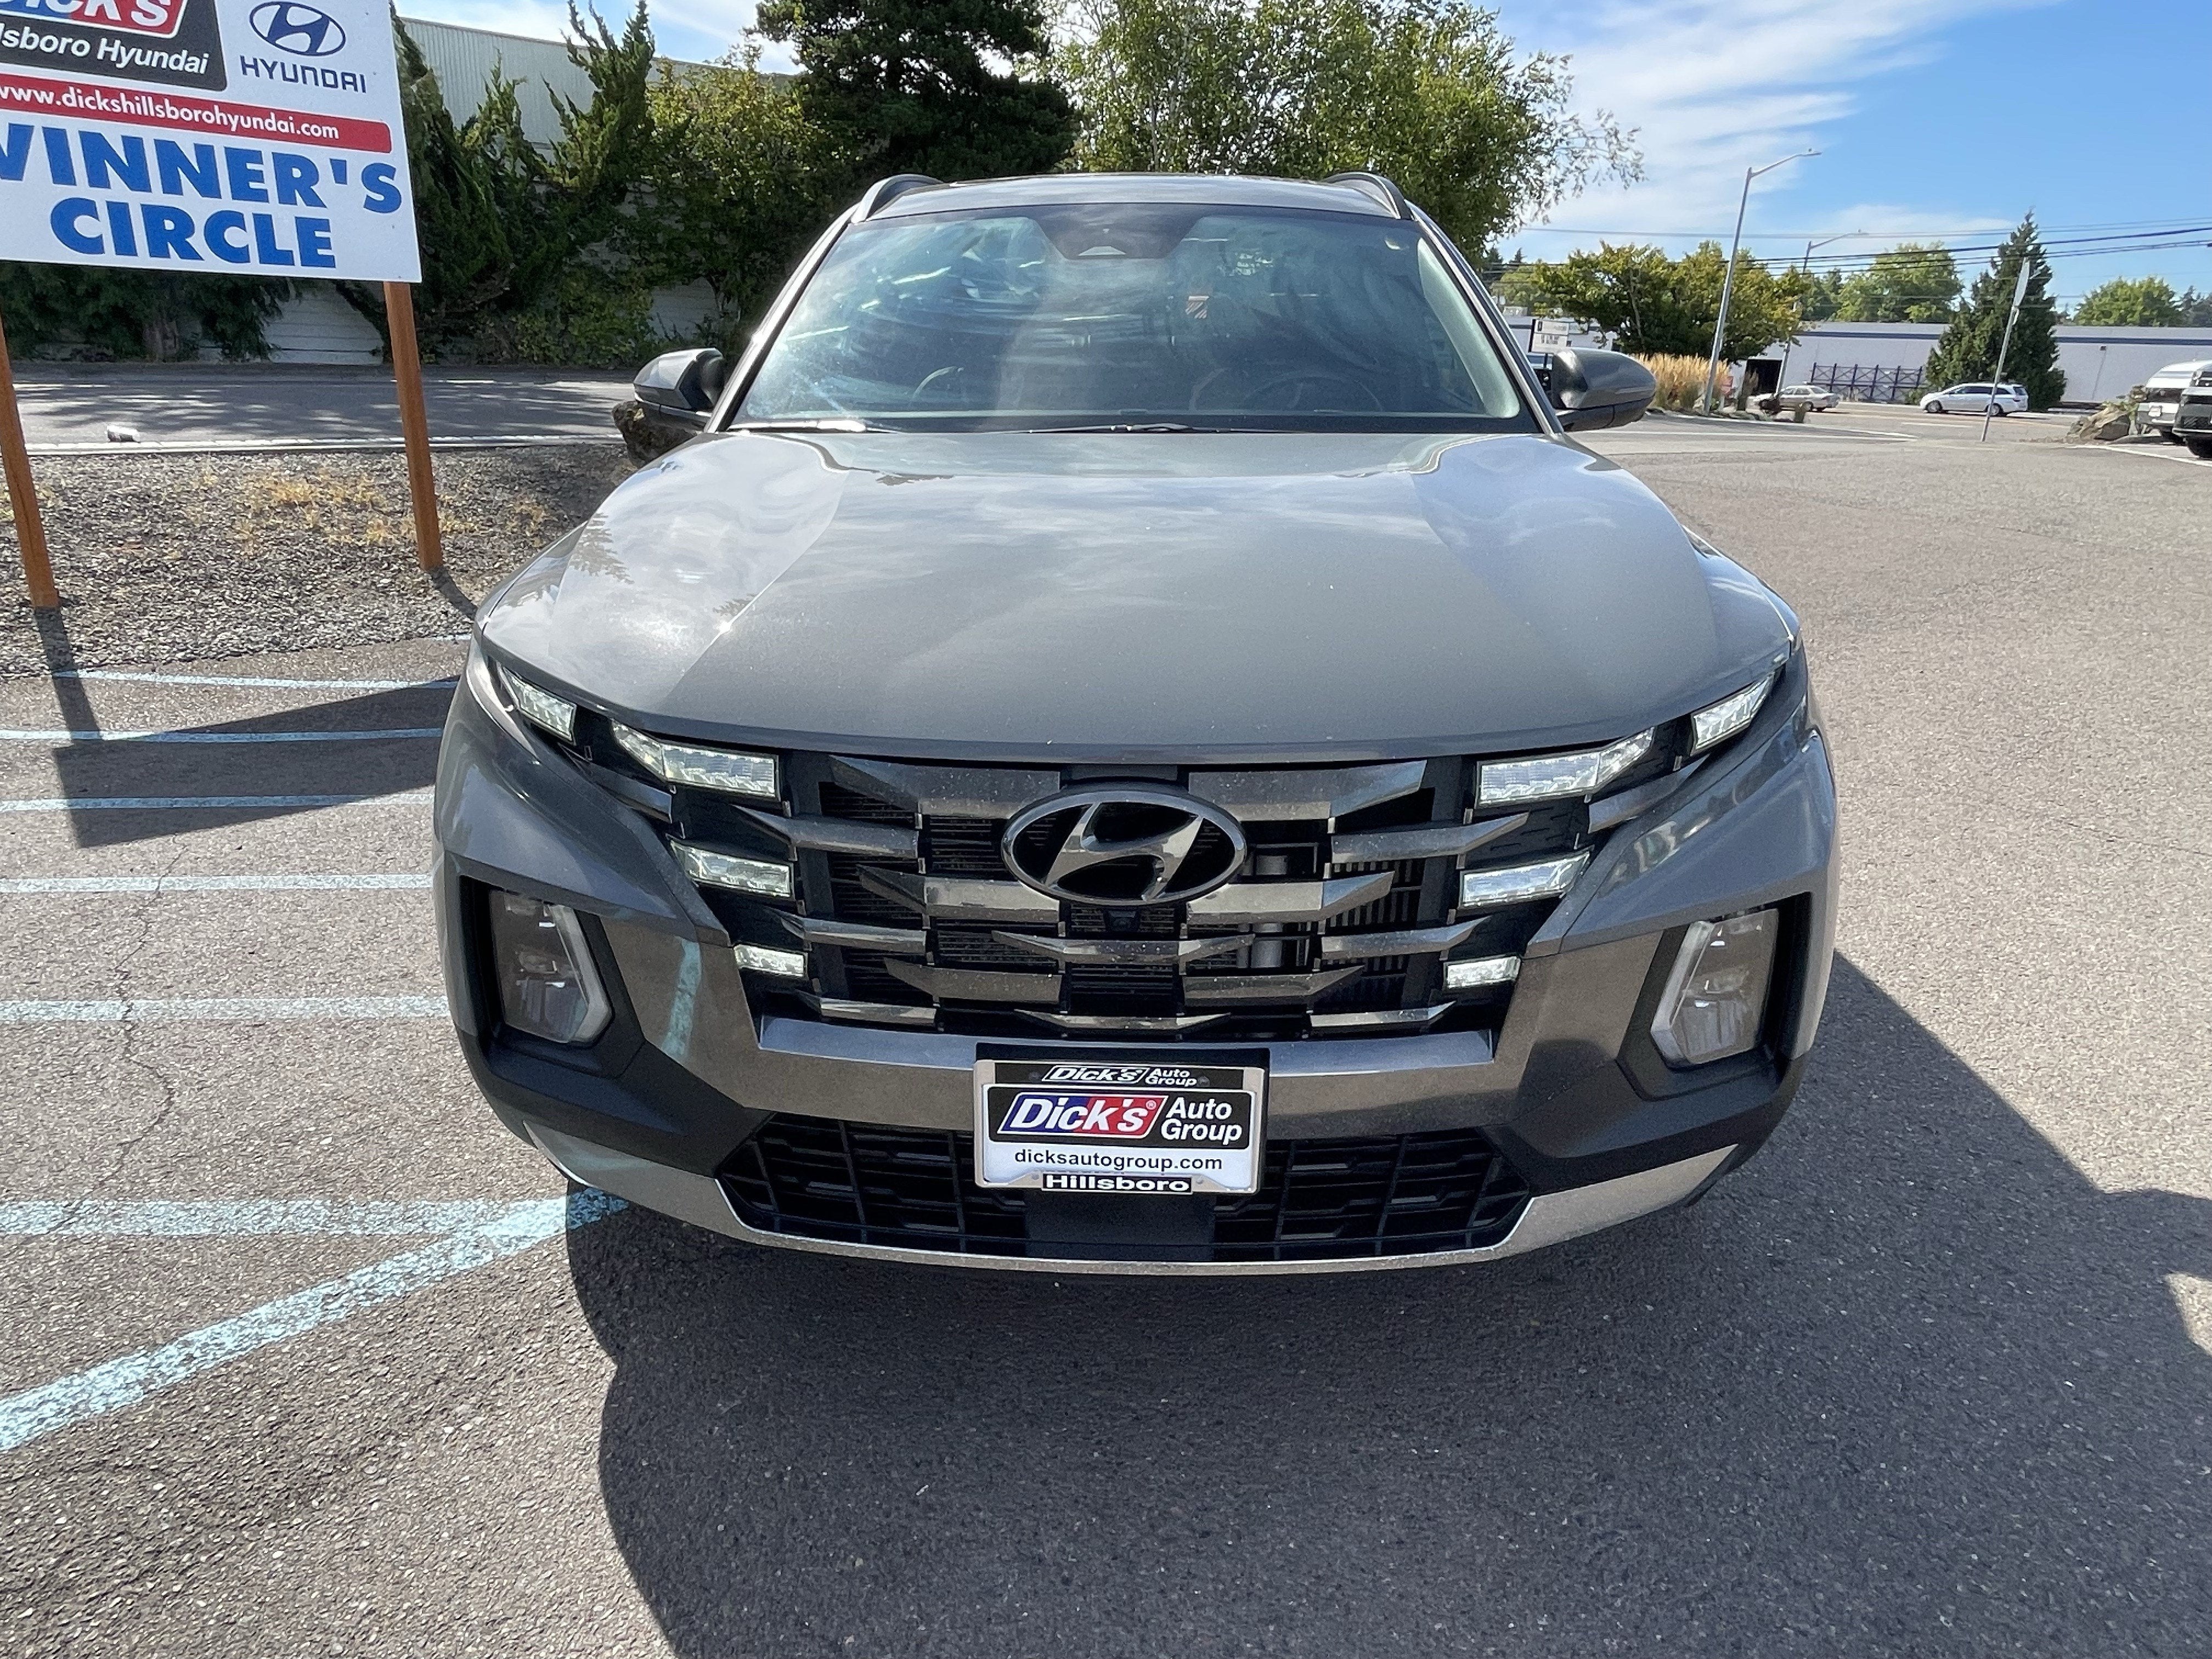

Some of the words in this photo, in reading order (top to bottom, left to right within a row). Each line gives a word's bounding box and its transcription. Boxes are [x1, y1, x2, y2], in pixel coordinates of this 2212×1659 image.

[97, 38, 210, 75] Hyundai
[240, 55, 366, 93] HYUNDAI
[50, 198, 336, 268] CIRCLE
[1145, 1077, 1198, 1087] Group
[1148, 1068, 1190, 1077] Auto
[1165, 1097, 1232, 1120] Auto
[1161, 1118, 1243, 1145] Group
[1014, 1149, 1222, 1171] dicksautogroup.com
[1046, 1175, 1190, 1191] Hillsboro
